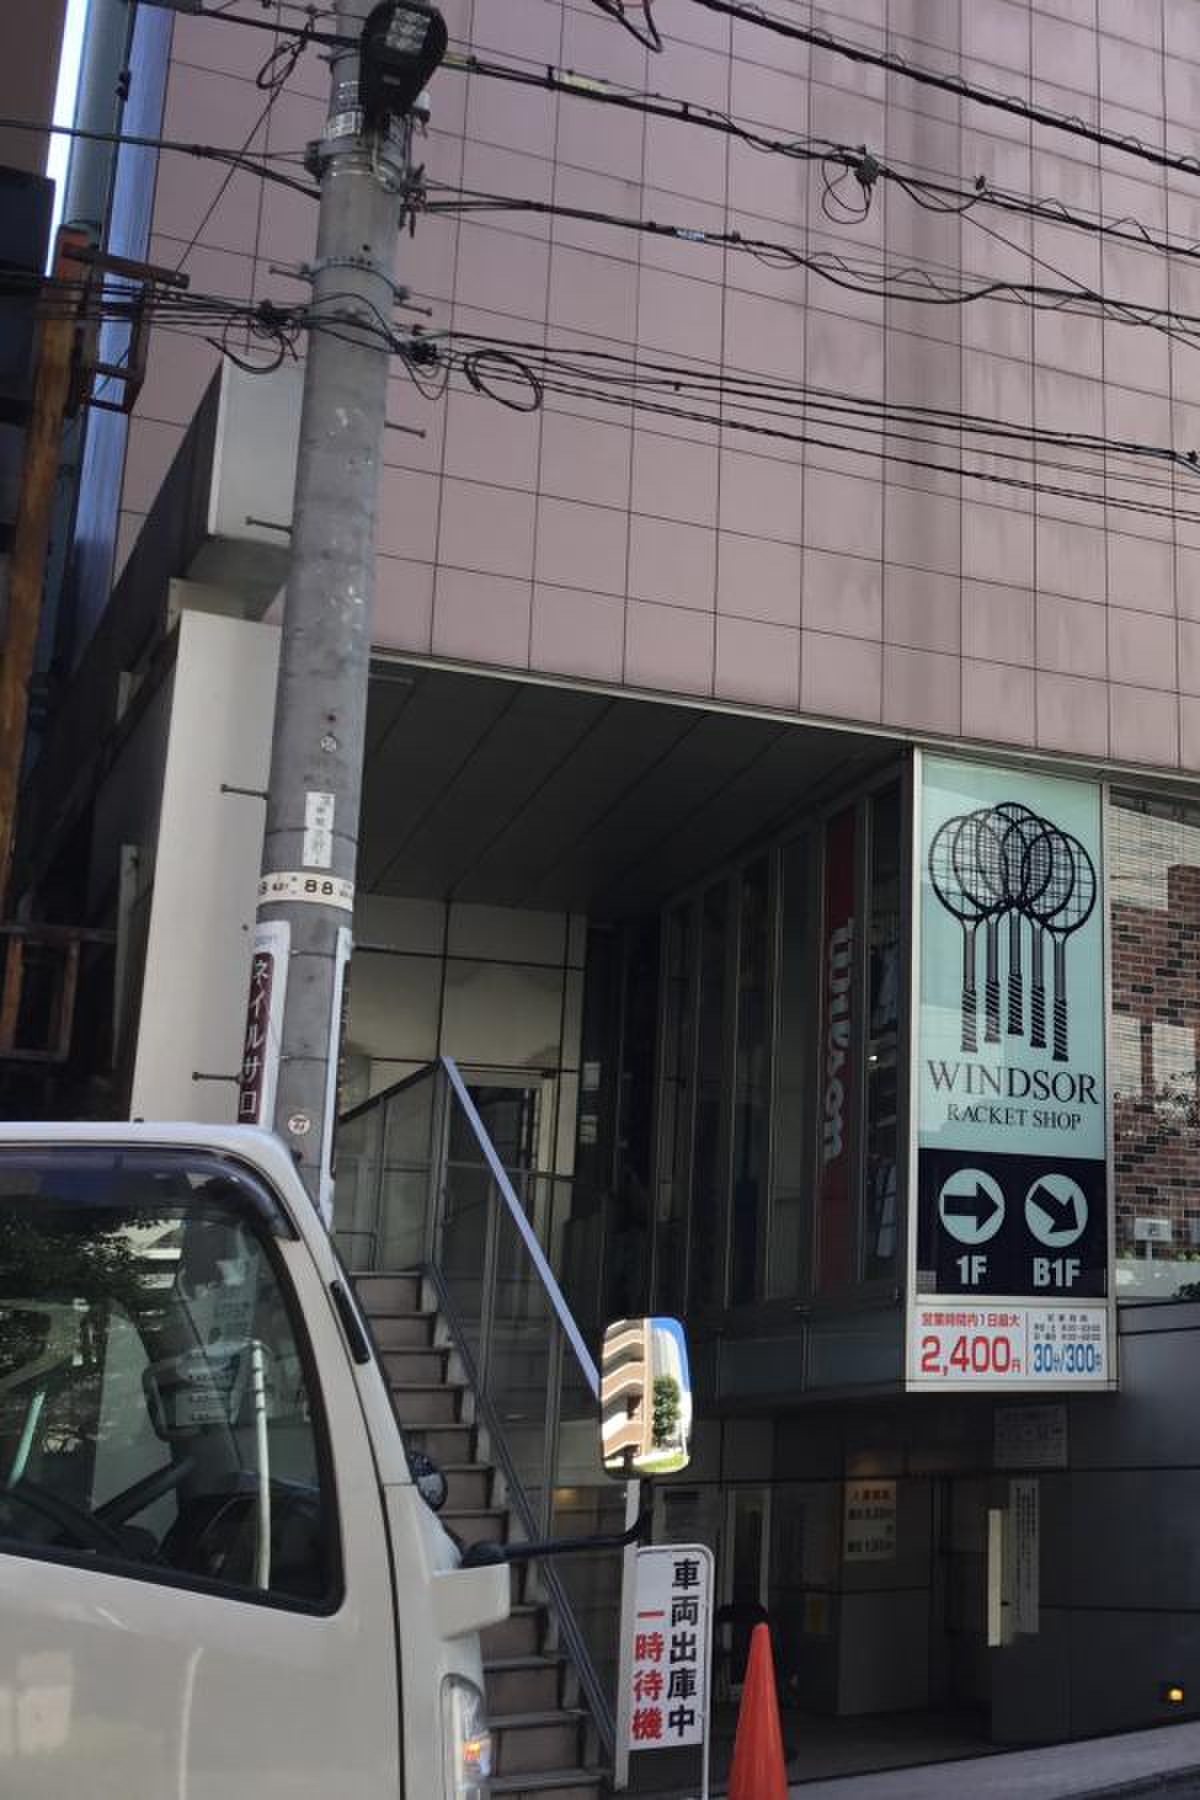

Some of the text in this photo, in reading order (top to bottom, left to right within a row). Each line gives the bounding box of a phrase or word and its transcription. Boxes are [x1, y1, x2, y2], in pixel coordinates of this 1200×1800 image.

[927, 1059, 1100, 1105] WINDSOR
[947, 1102, 1082, 1132] RACKET SHOP
[957, 1255, 988, 1285] 1F
[1033, 1257, 1082, 1288] B1F
[667, 1558, 700, 1738] 車両出庫中
[632, 1609, 665, 1741] 一時待機
